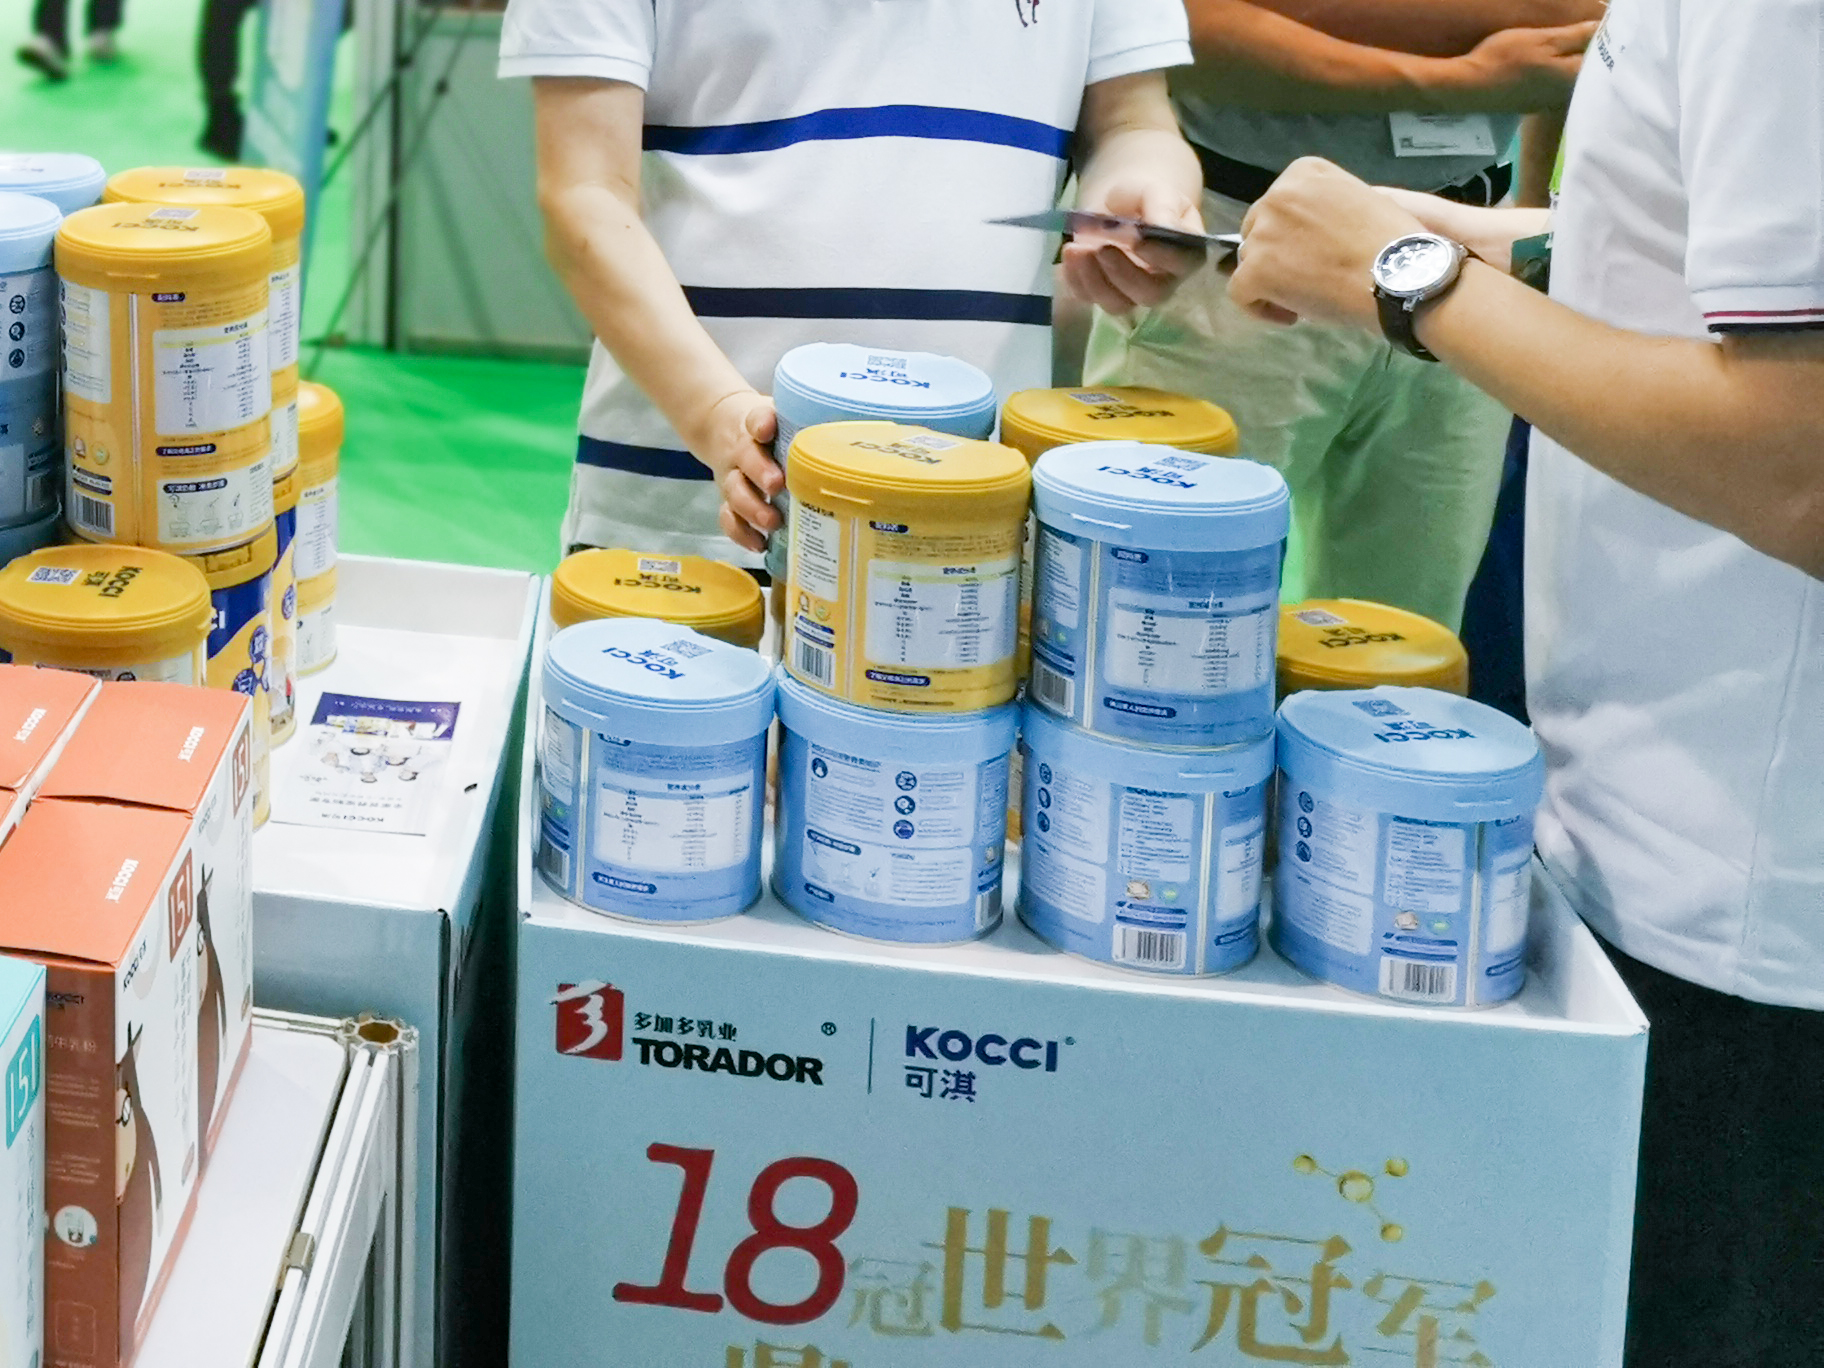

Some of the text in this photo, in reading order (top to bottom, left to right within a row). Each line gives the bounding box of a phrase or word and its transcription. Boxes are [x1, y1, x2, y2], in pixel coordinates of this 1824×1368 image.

[840, 370, 931, 390] KOCCI
[850, 440, 943, 465] KOCCI
[1096, 465, 1198, 489] KOCCI
[97, 565, 144, 599] KOCCI
[613, 577, 702, 593] KOCCI
[600, 646, 687, 680] KOCCI
[632, 1036, 824, 1086] TORADOR
[905, 1024, 1058, 1072] KOCCI
[905, 1064, 977, 1104] 可淇
